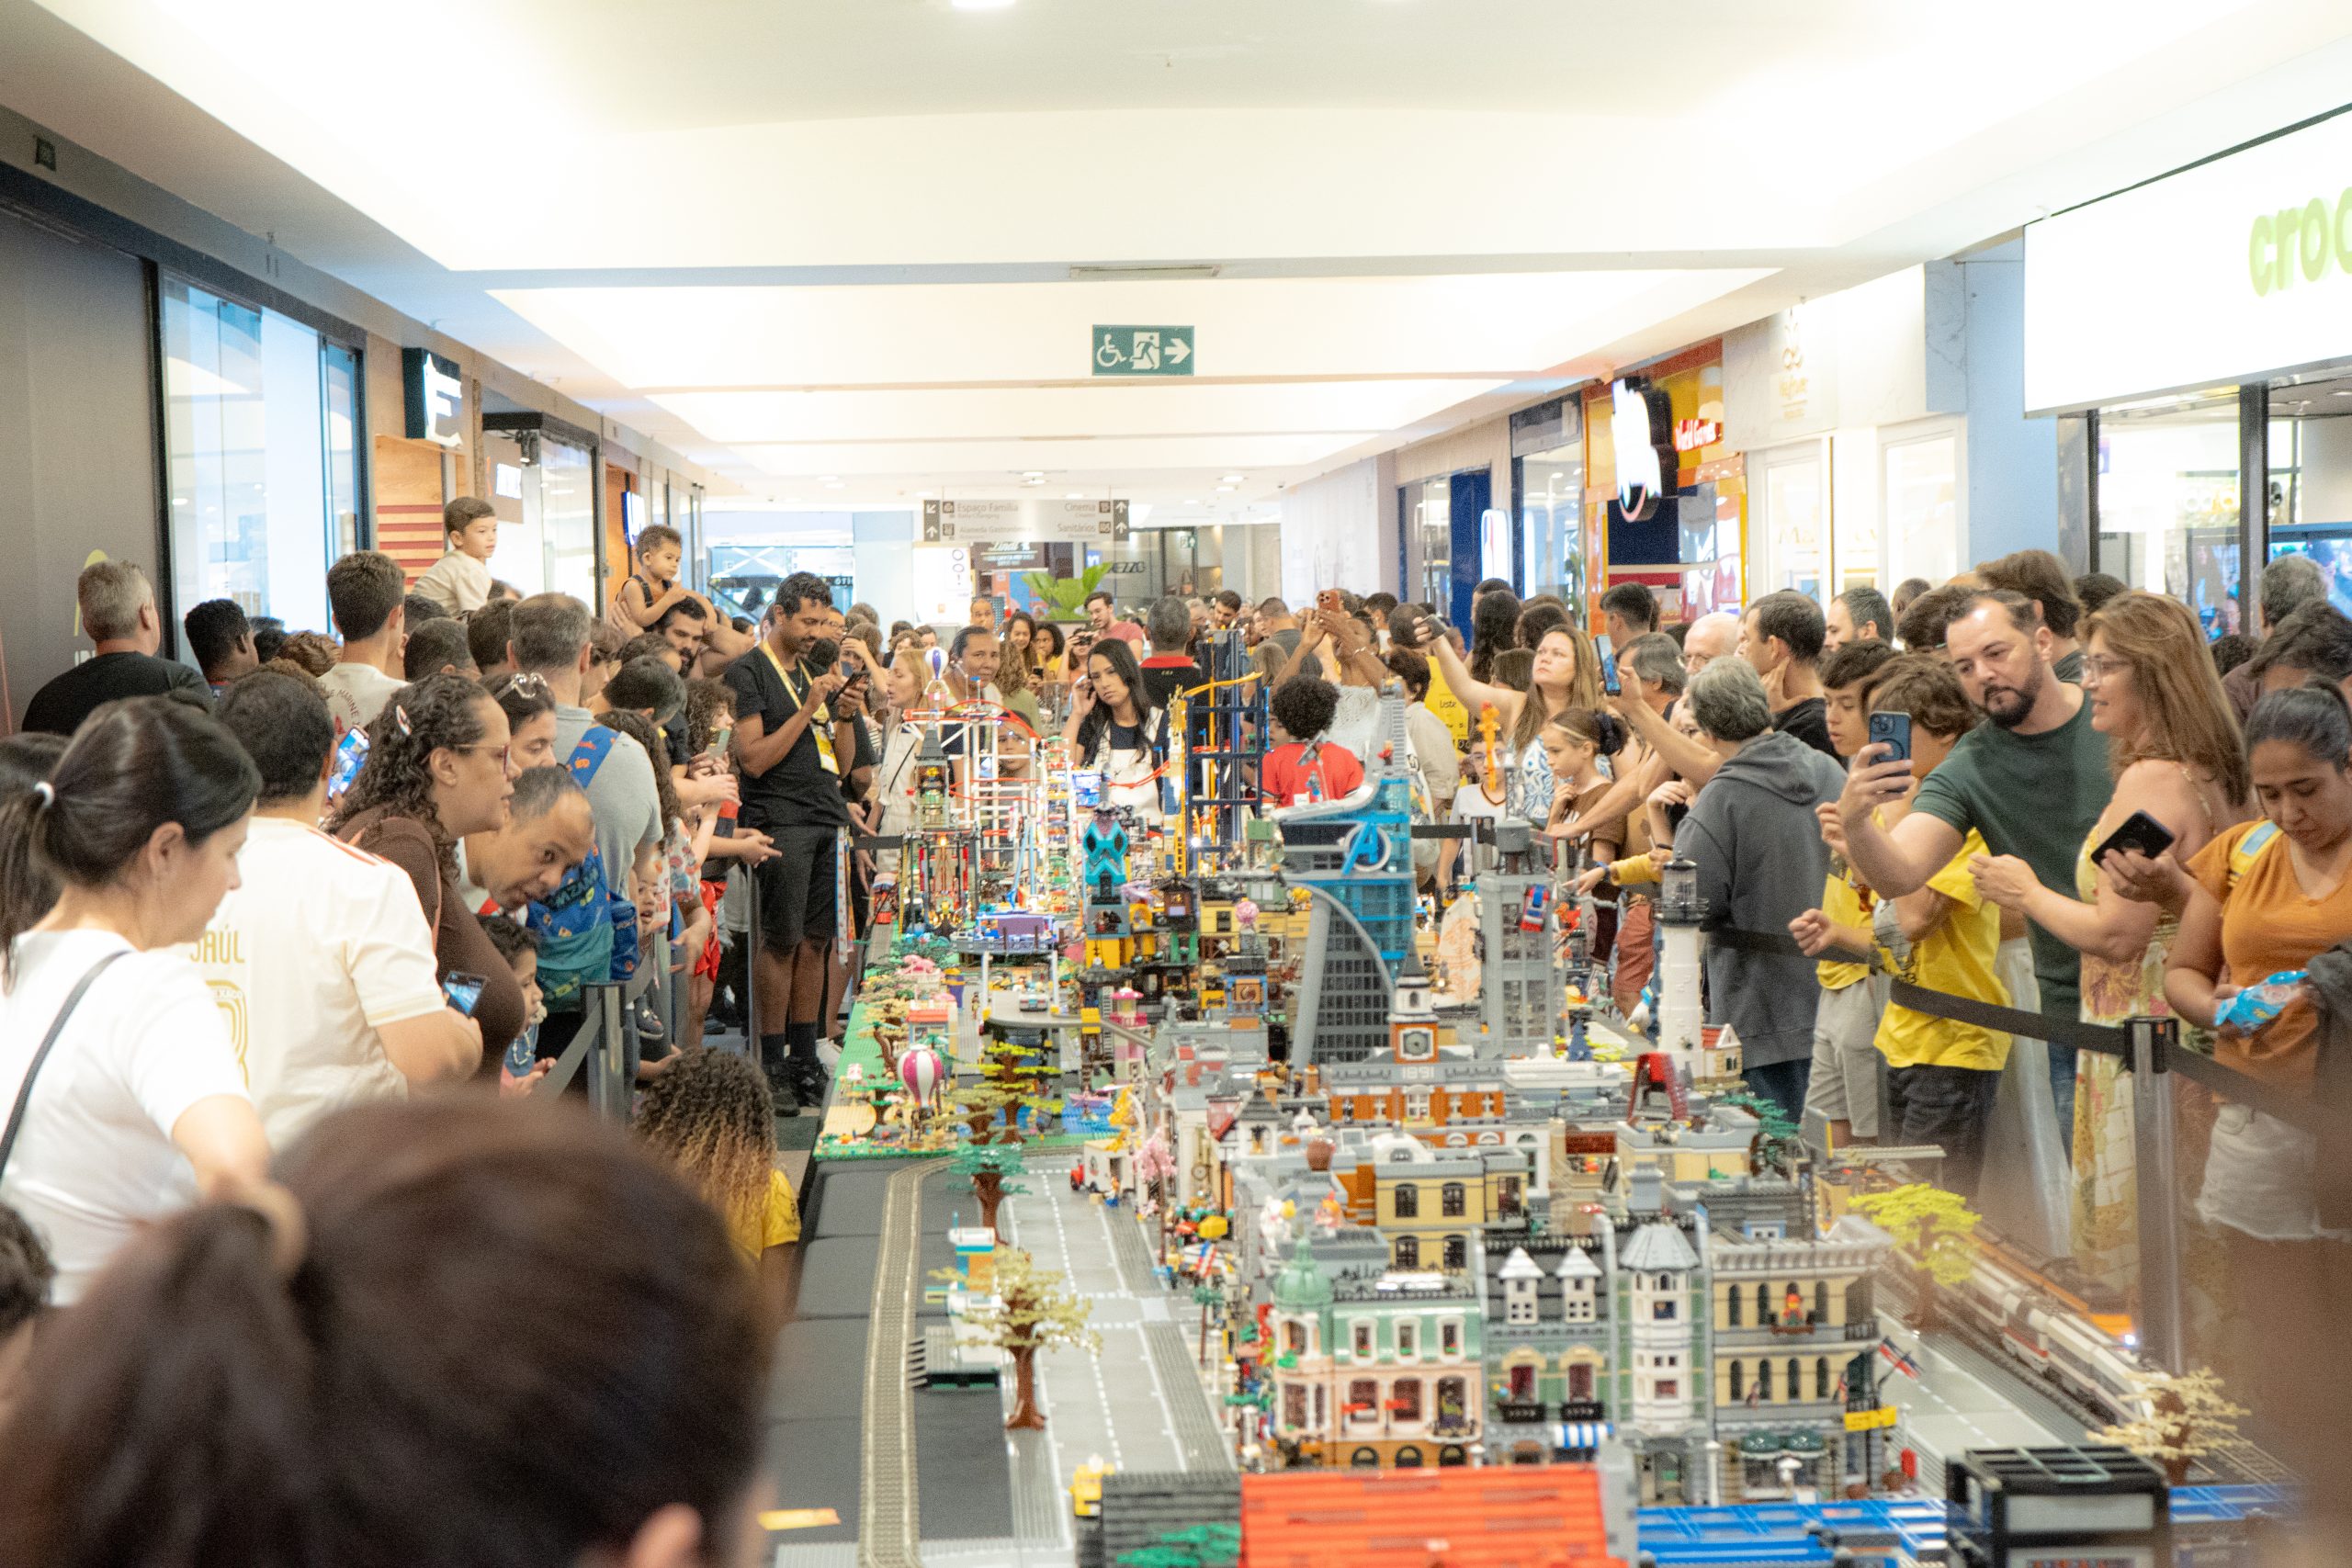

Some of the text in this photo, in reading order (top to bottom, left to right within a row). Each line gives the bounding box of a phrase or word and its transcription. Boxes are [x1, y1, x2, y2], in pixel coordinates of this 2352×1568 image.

[957, 502, 1019, 514] Espaço Família
[1064, 502, 1096, 512] Cinema
[1057, 523, 1096, 533] Sanitários
[1402, 1066, 1434, 1080] 1891
